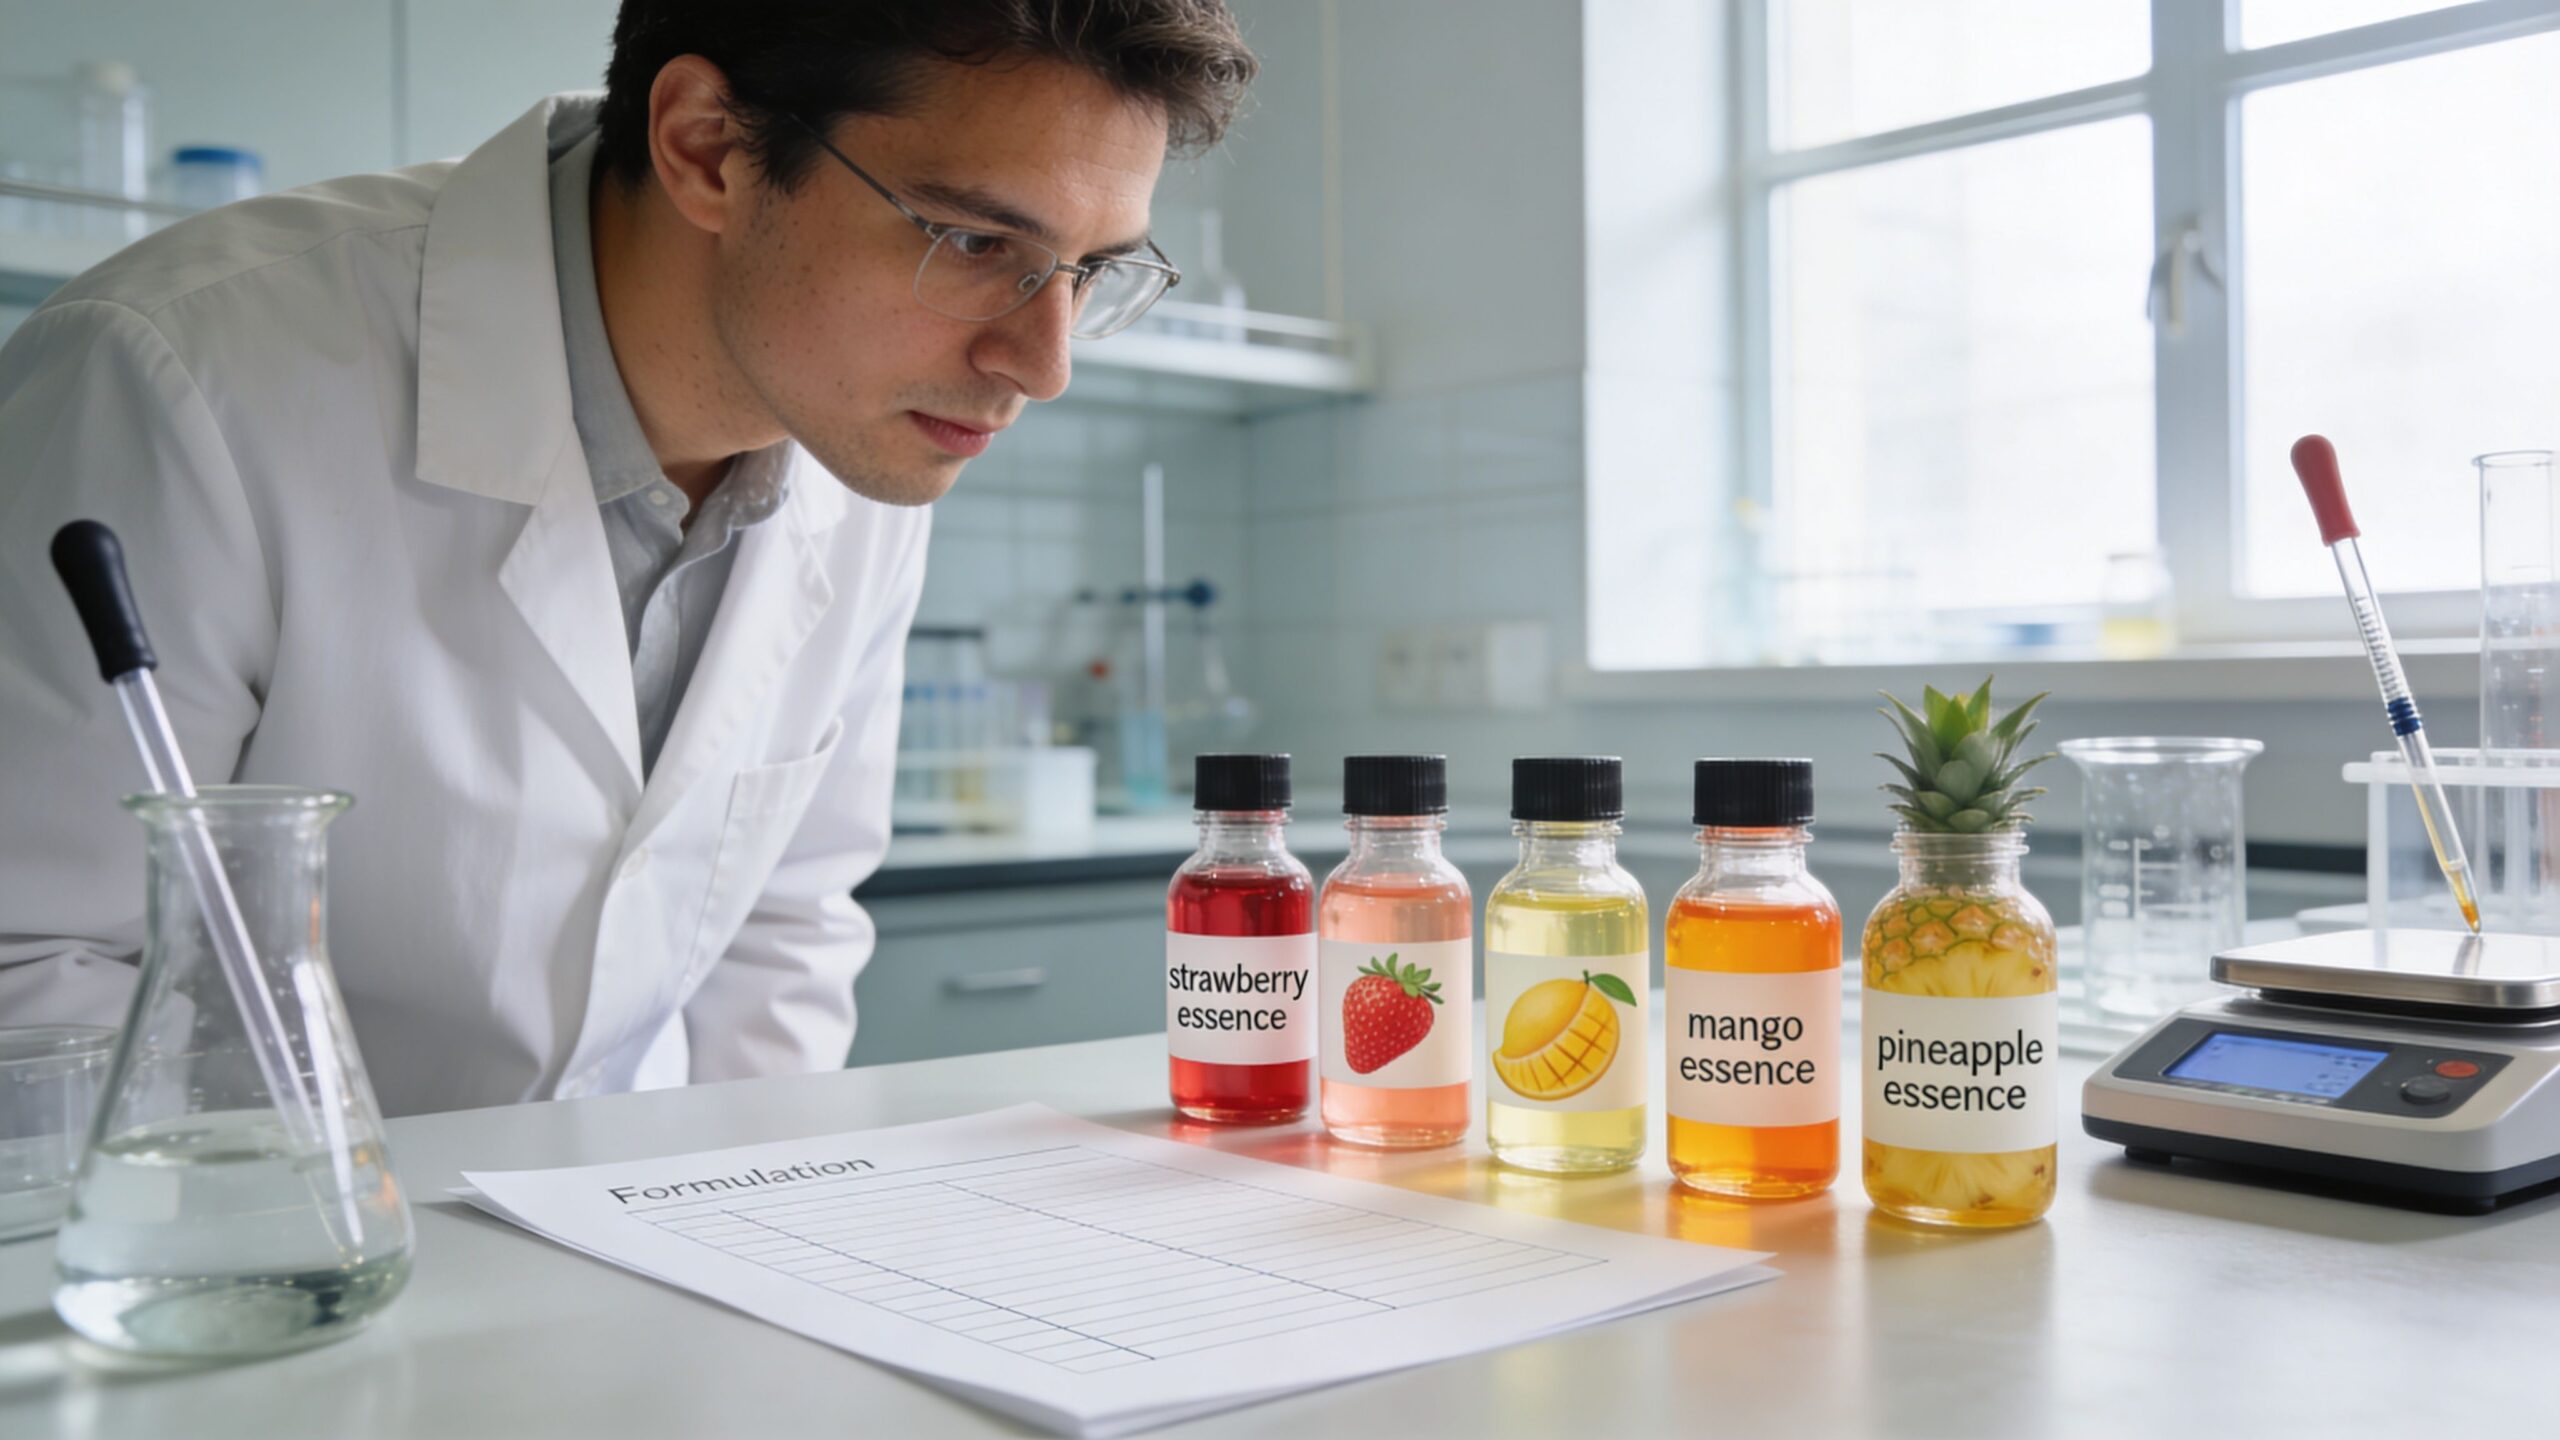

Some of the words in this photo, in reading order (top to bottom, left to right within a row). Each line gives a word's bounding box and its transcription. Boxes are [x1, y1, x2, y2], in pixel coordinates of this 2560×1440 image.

[1169, 962, 1309, 1001] strawberry
[1177, 1006, 1287, 1031] essence
[1688, 1013, 1804, 1051] mango
[1679, 1056, 1816, 1085] essence
[1877, 1028, 2043, 1076] pineapple
[1883, 1080, 2027, 1111] essence
[607, 1159, 876, 1205] Formulation
